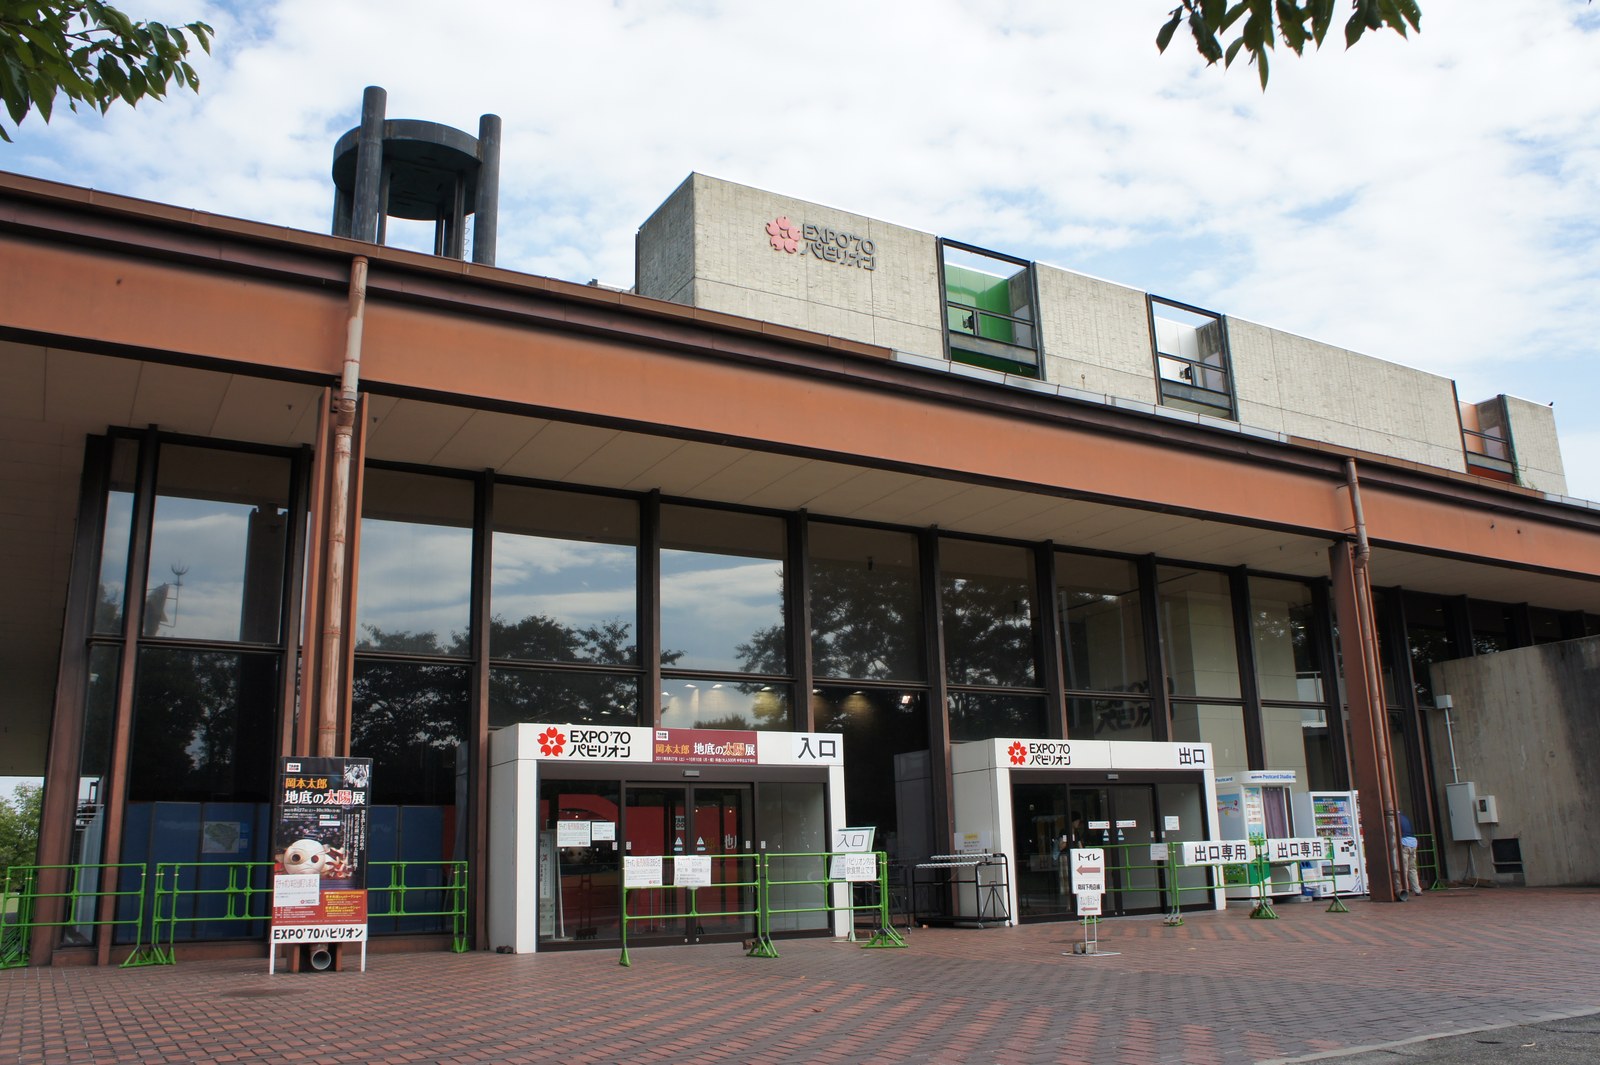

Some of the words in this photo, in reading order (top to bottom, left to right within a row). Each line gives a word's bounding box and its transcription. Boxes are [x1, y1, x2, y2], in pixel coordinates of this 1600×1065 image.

[802, 223, 876, 255] EXPO'70
[800, 242, 876, 271] パビリオン
[570, 730, 631, 745] EXPO'70
[569, 744, 631, 758] パビリオン
[797, 737, 836, 759] 入口
[1029, 743, 1071, 755] EXPO'70
[1029, 754, 1071, 766] パビリオン
[1179, 747, 1205, 765] 出口
[285, 777, 328, 789] 岡本太郎
[284, 788, 366, 805] 地底の太陽展
[837, 834, 865, 848] 入口
[1078, 853, 1101, 861] トイレ
[1194, 844, 1247, 862] 出口専用
[1277, 841, 1322, 859] 出口専用
[273, 926, 364, 940] EXPO'70パビリオン
